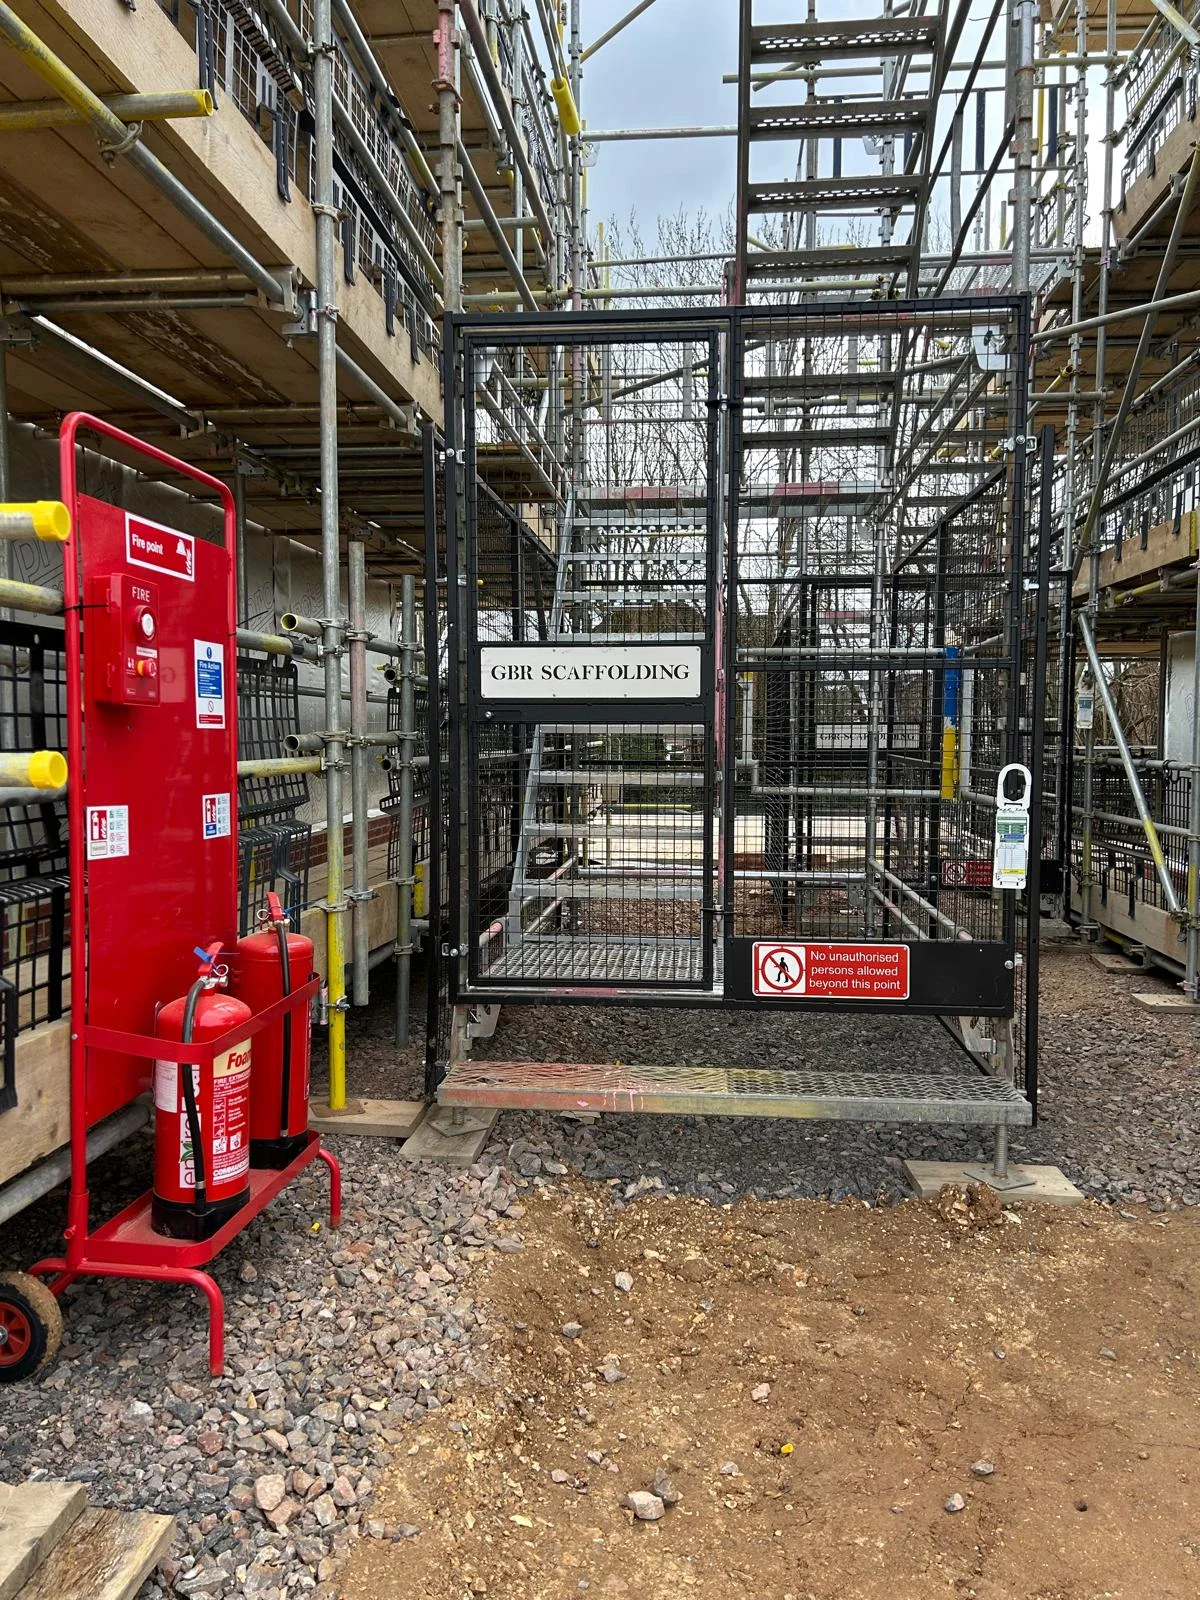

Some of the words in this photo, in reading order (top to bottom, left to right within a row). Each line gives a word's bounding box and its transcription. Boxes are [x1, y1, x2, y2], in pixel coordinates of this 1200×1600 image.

[132, 533, 145, 549] Fire
[146, 541, 163, 555] point
[132, 586, 150, 603] FIRE
[490, 664, 533, 680] GBR
[541, 664, 690, 680] SCAFFOLDING
[810, 951, 826, 961] No
[829, 951, 899, 963] unauthorised
[811, 966, 854, 979] persons
[857, 966, 898, 976] allowed
[809, 978, 849, 990] beyond
[851, 979, 871, 989] this
[874, 980, 901, 991] point
